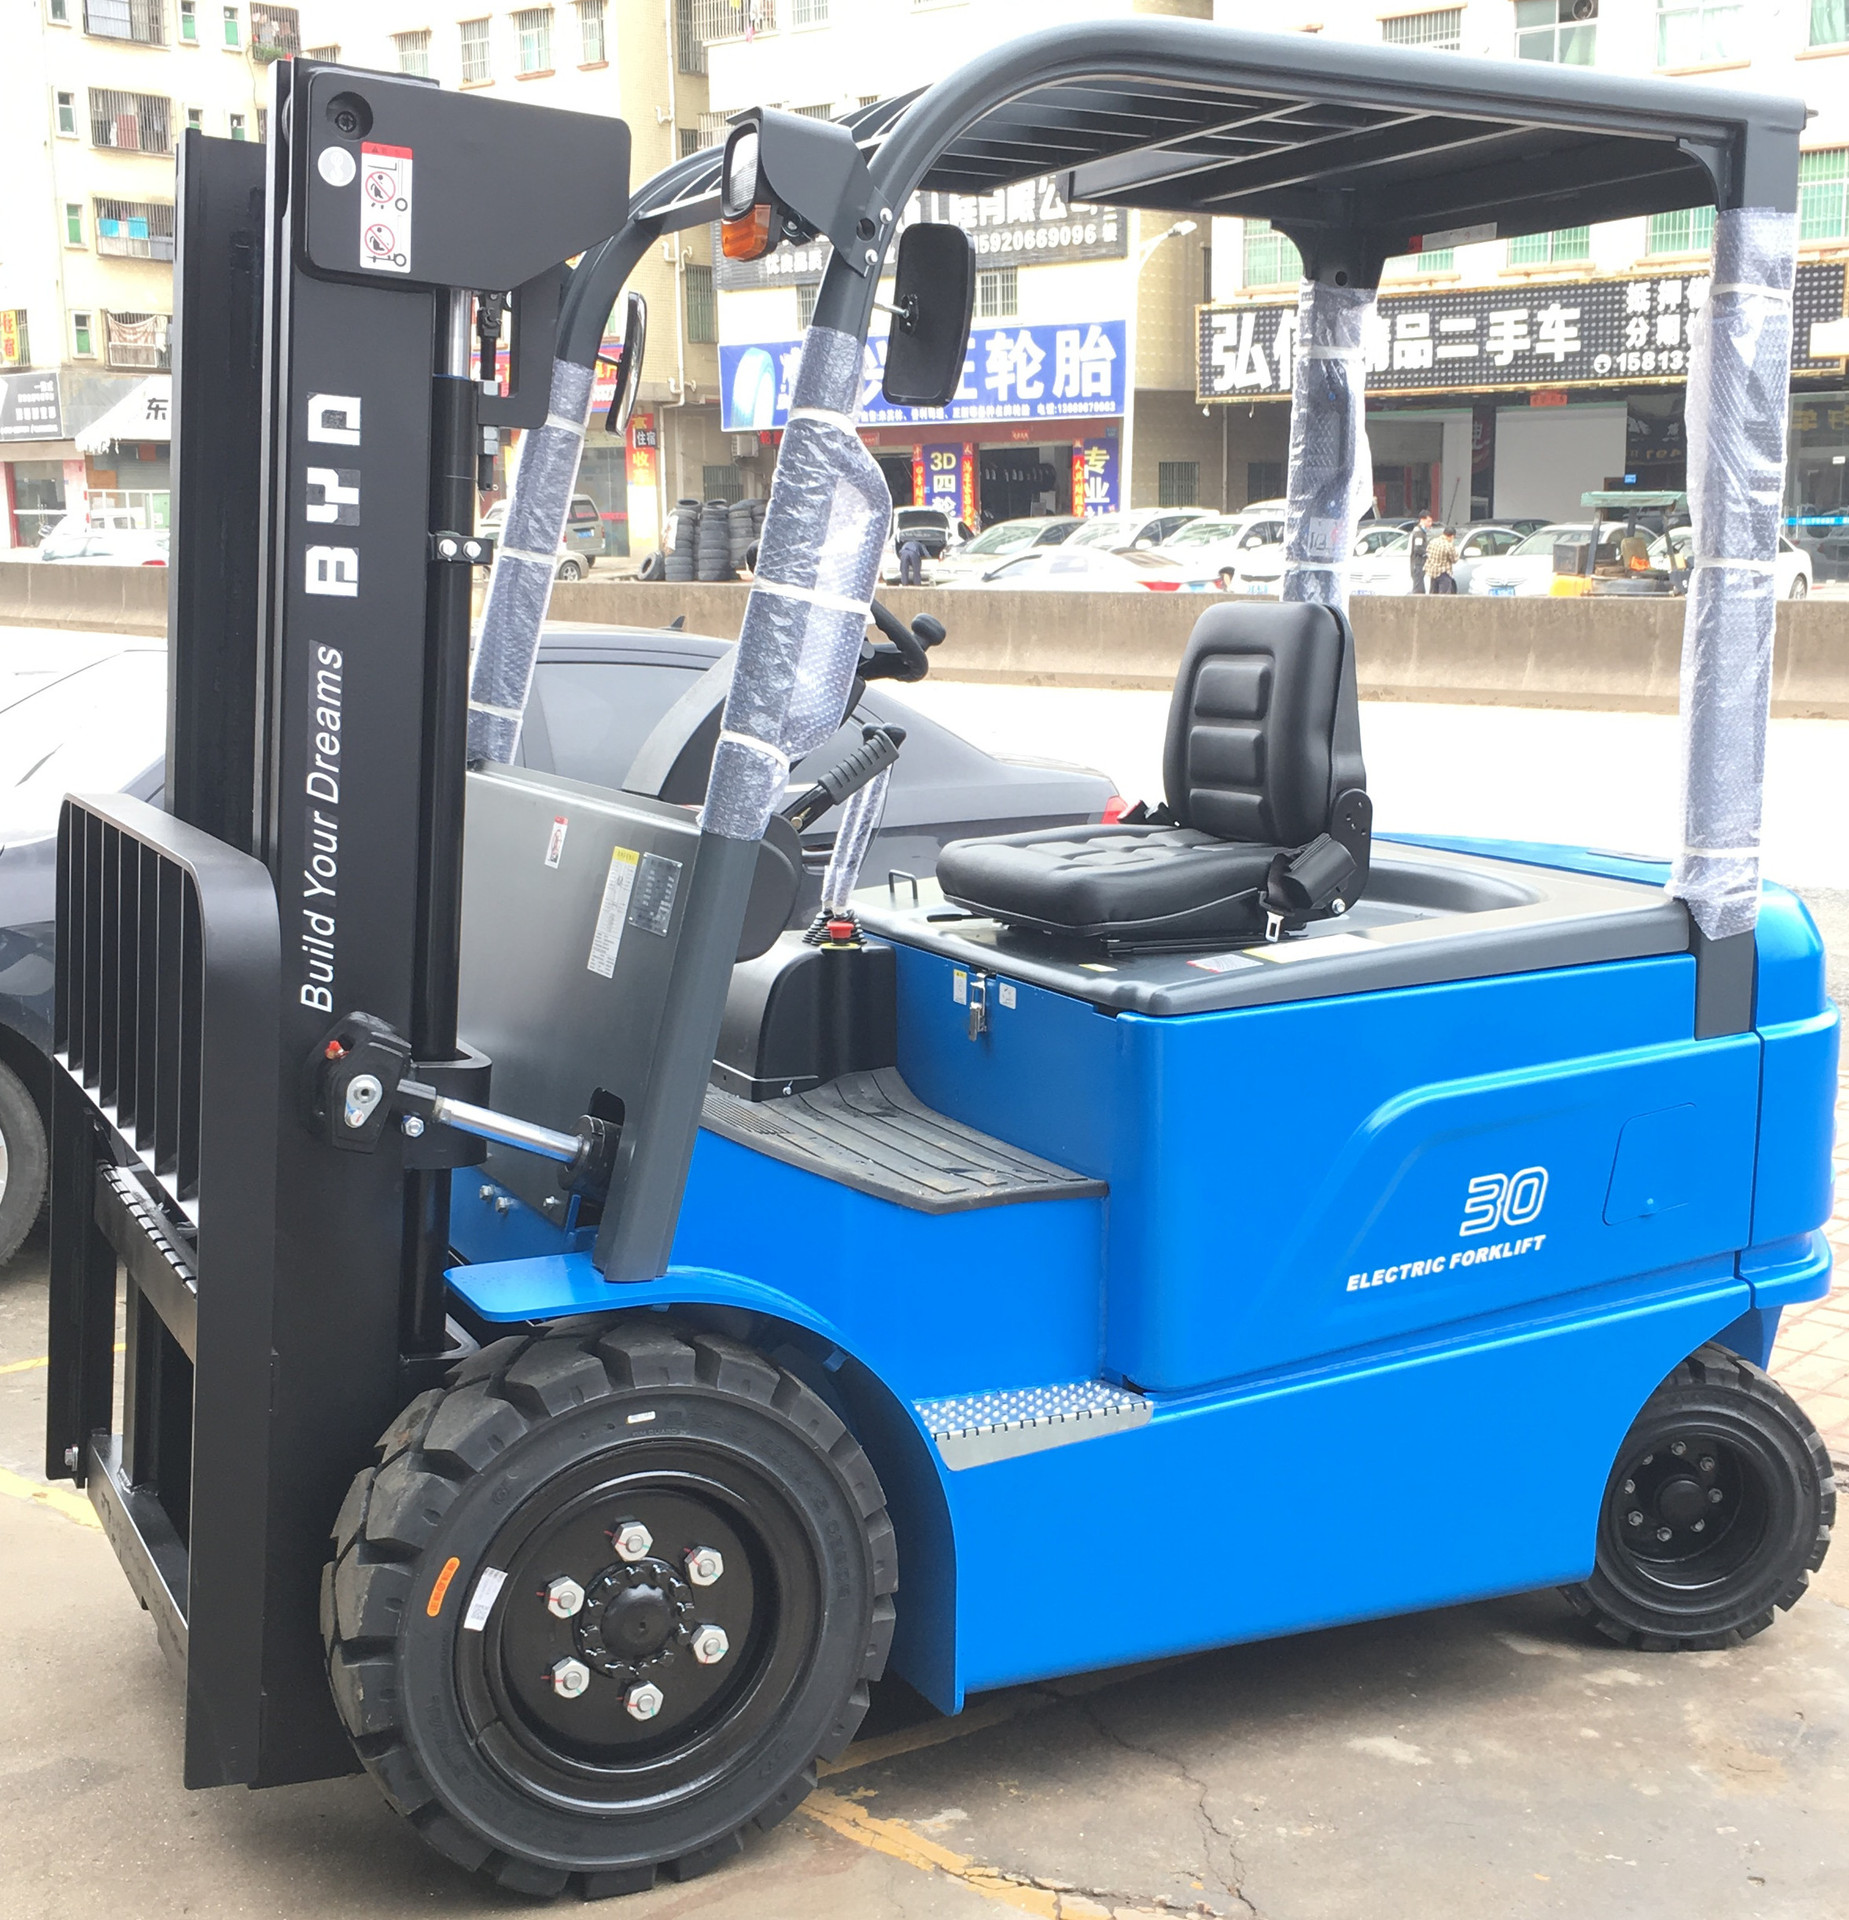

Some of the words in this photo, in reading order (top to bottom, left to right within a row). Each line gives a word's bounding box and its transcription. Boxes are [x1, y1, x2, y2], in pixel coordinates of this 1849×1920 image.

[145, 397, 169, 420] 东
[637, 430, 657, 446] 住宿
[305, 394, 361, 597] BYD
[306, 649, 343, 803] Dreams
[304, 812, 338, 898] Your
[301, 910, 335, 1012] Build
[1459, 1166, 1549, 1236] 30
[1346, 1256, 1446, 1292] ELECTRIC
[1450, 1234, 1546, 1269] FORKLIFT
